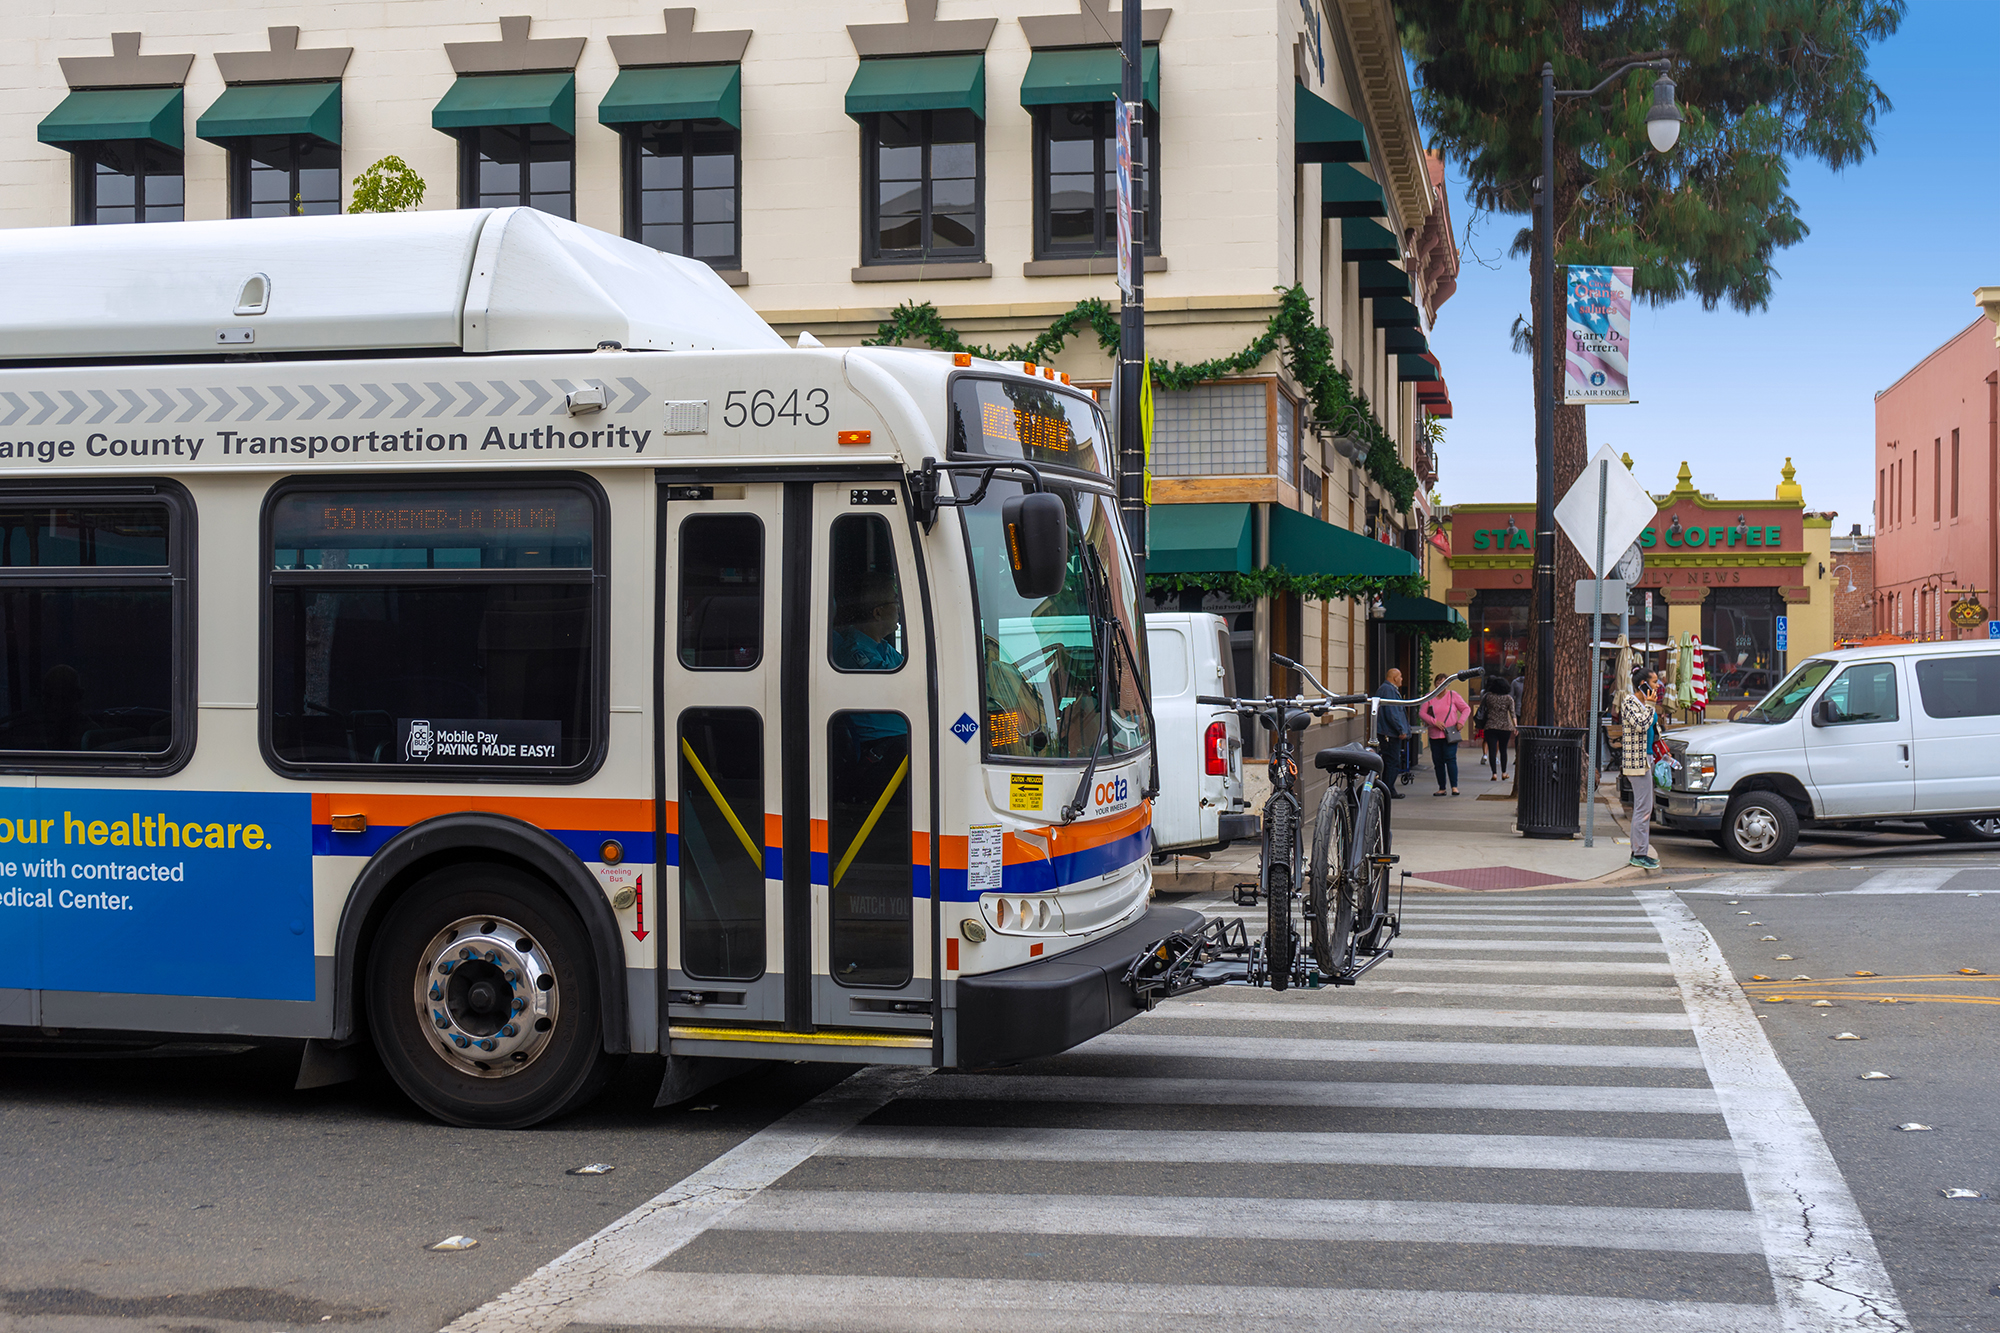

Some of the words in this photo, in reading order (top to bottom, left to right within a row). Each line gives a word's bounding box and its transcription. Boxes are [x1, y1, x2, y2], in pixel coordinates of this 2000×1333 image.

[1588, 280, 1605, 288] City
[1604, 280, 1613, 288] of
[1574, 284, 1625, 301] Orange
[1579, 303, 1618, 315] salutes
[1572, 330, 1606, 343] Garry
[1609, 330, 1623, 341] D.
[1575, 341, 1619, 353] Herrera
[1567, 389, 1582, 397] U.S.
[1583, 389, 1599, 397] AIR
[1600, 389, 1628, 397] FORCE
[723, 388, 831, 429] 5643
[0, 440, 76, 464] ange
[86, 432, 205, 461] County
[216, 427, 468, 459] Transportation
[480, 423, 652, 454] Authority
[324, 507, 356, 530] 59
[493, 508, 556, 528] PALMA
[1664, 525, 1782, 548] COFFEE
[1687, 571, 1741, 585] NEWS
[414, 731, 427, 739] OC
[953, 722, 977, 734] CNG
[436, 730, 474, 743] Mobile
[477, 731, 499, 745] Pay
[436, 743, 478, 756] PAYING
[481, 745, 516, 757] MADE
[520, 745, 555, 757] EASY!
[1095, 774, 1128, 807] octa
[1095, 806, 1110, 816] YOUR
[1109, 802, 1128, 813] WHEELS
[0, 817, 55, 844] our
[64, 811, 272, 850] healthcare.
[22, 858, 66, 879] with
[71, 861, 184, 882] contracted
[600, 867, 632, 876] Kneeling
[609, 875, 624, 883] Bus
[0, 886, 54, 909] dical
[58, 889, 134, 911] Center.
[849, 895, 886, 915] WATCH
